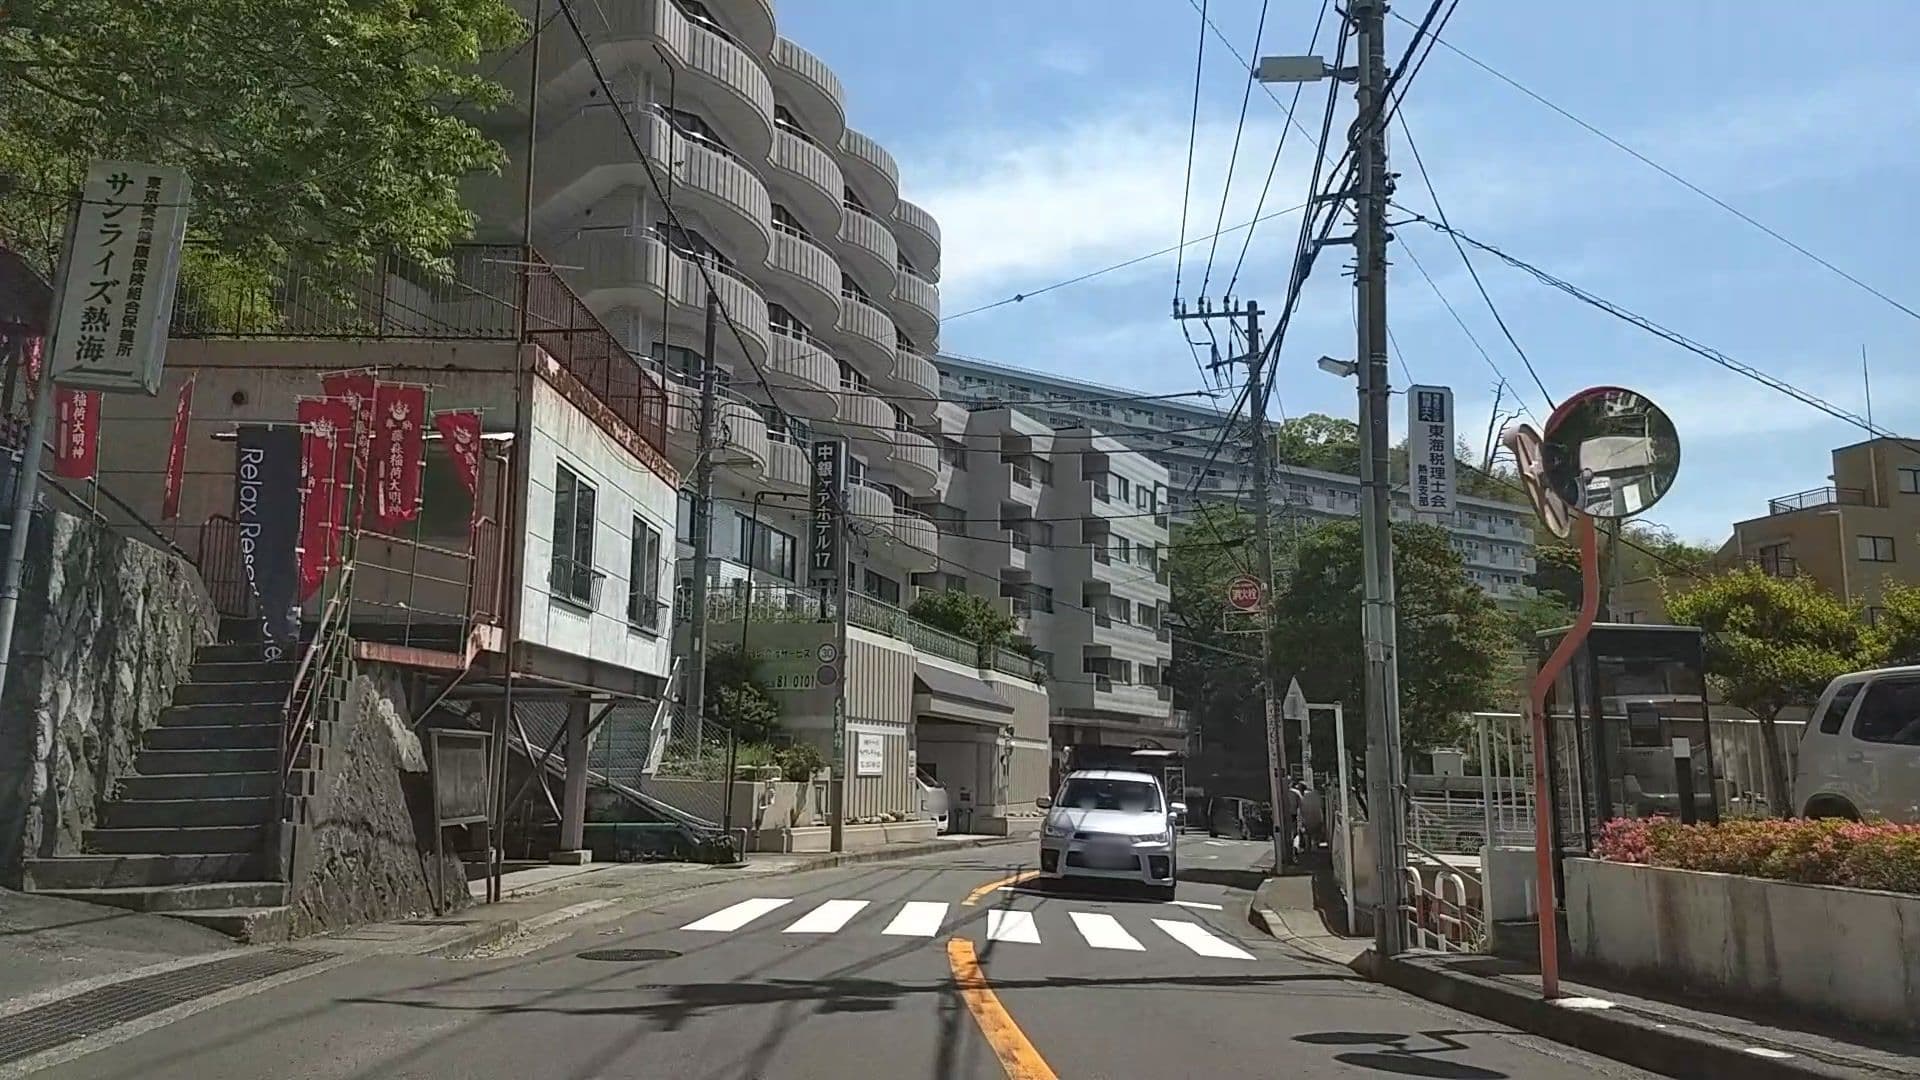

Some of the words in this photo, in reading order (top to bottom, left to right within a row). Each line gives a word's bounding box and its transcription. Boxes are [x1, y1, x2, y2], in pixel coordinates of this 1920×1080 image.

[76, 172, 134, 362] サンライズ熱海
[239, 447, 264, 516] Relax
[1418, 463, 1429, 507] 熱海支部
[1428, 424, 1447, 508] 東海税理士会
[1231, 587, 1257, 601] 消火栓
[821, 647, 834, 658] 30
[777, 674, 787, 688] 81
[793, 674, 815, 688] 0101
